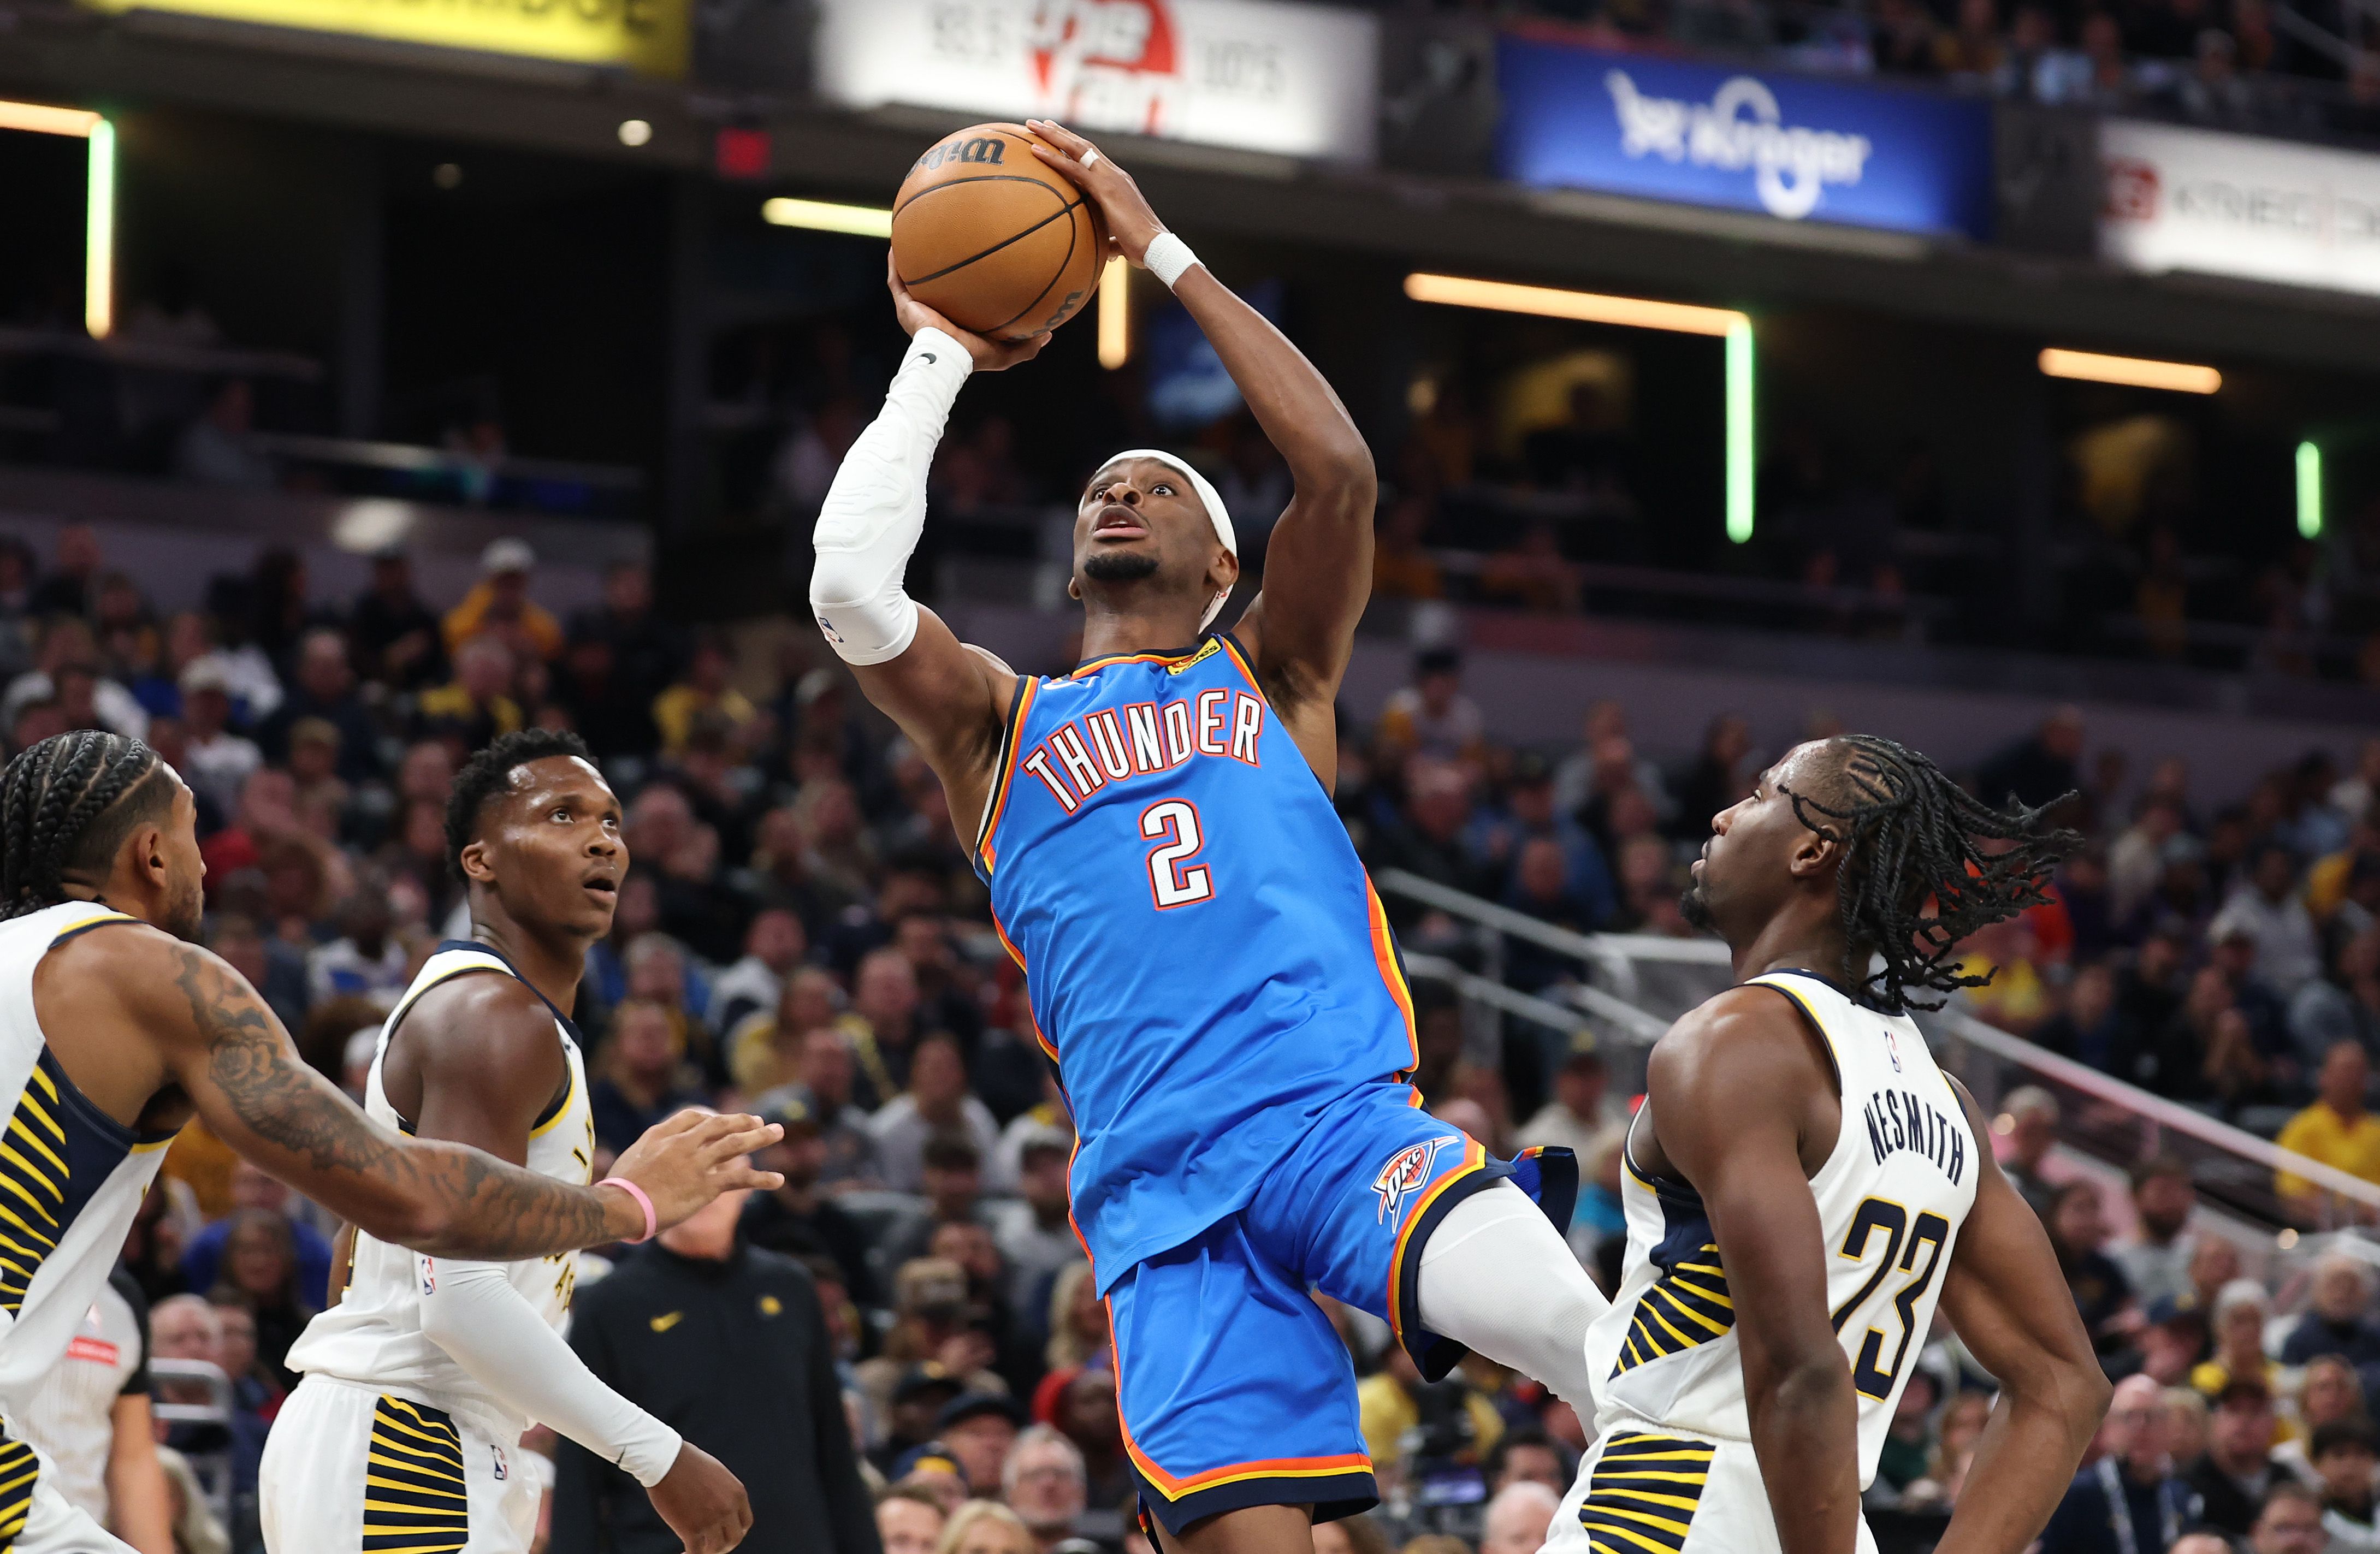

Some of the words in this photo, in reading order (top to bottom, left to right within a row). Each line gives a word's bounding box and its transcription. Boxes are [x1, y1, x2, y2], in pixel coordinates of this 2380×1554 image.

[1688, 75, 1872, 220] Kroger
[1020, 687, 1264, 816] THUNDER
[1138, 797, 1216, 911] 2
[1386, 1148, 1421, 1210] OKC
[1864, 1088, 1965, 1187] NESMITH
[1832, 1194, 1950, 1403] 23
